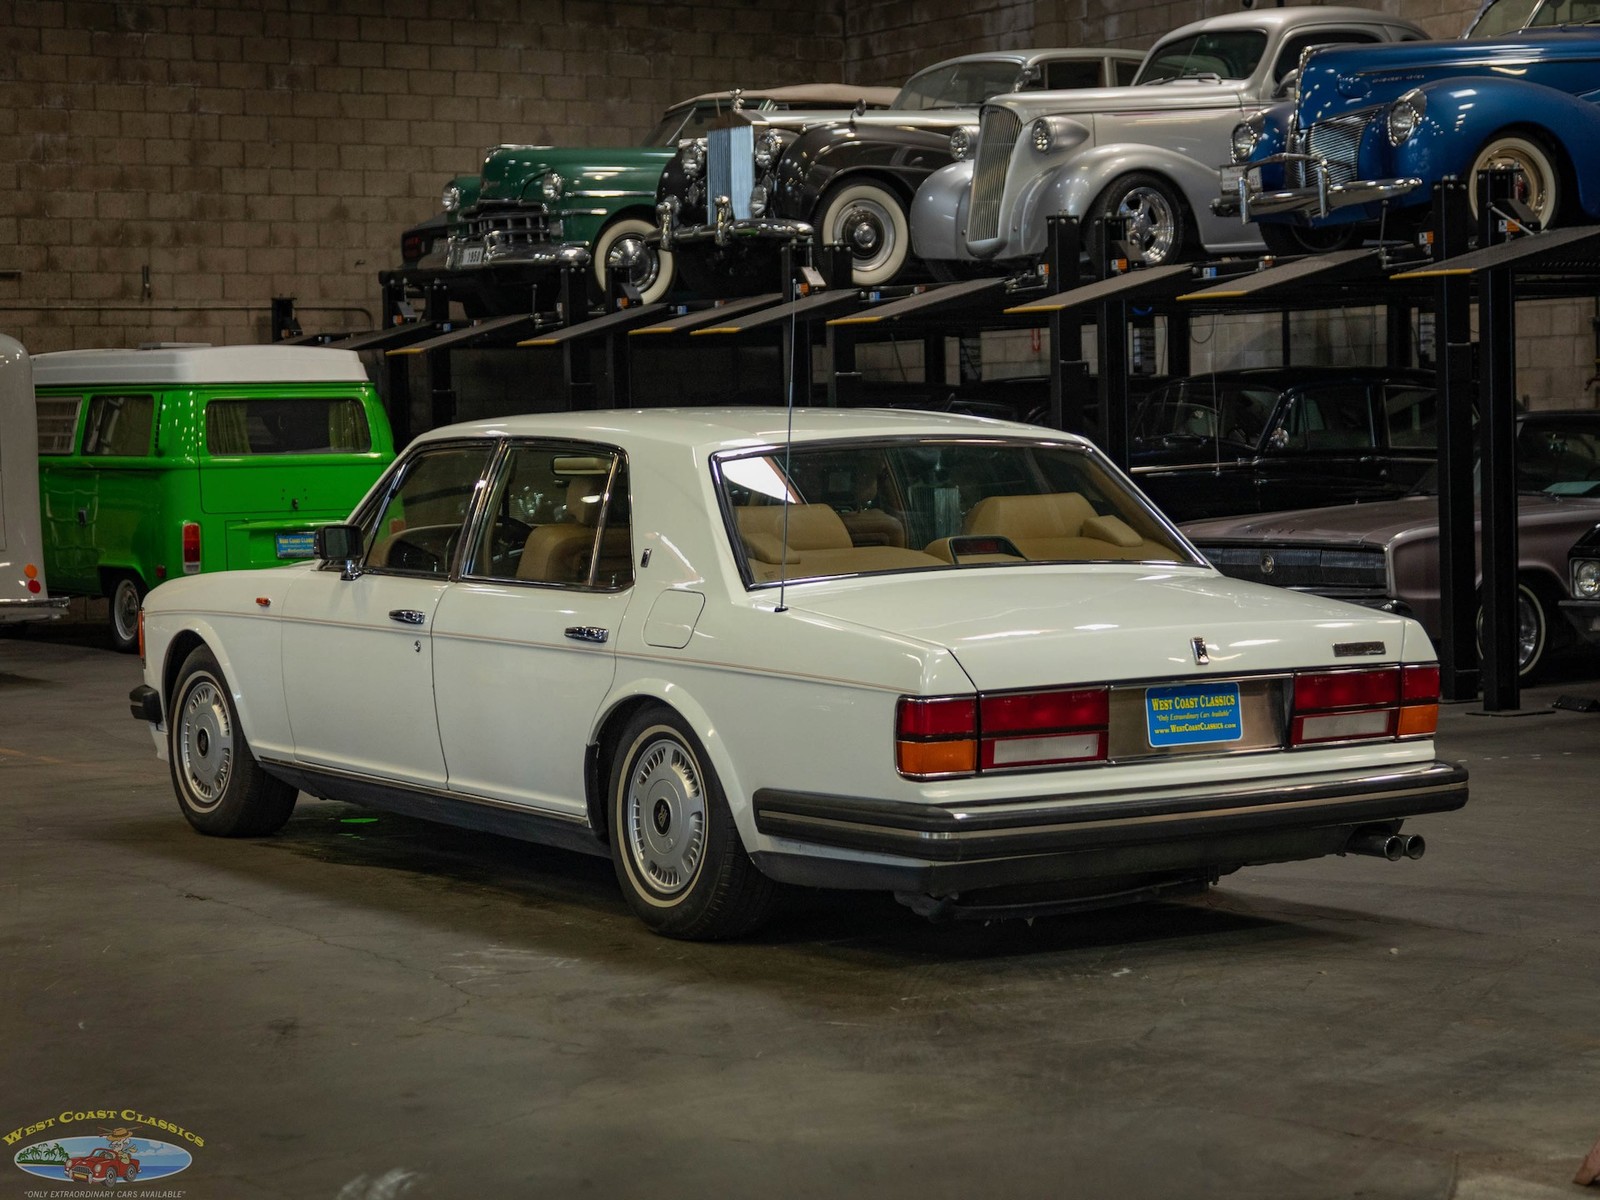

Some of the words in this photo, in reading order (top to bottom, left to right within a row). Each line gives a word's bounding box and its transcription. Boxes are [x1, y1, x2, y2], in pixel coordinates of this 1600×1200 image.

[1152, 698, 1173, 711] WEST
[1174, 697, 1198, 709] COAST
[1200, 695, 1235, 708] CLASSICS
